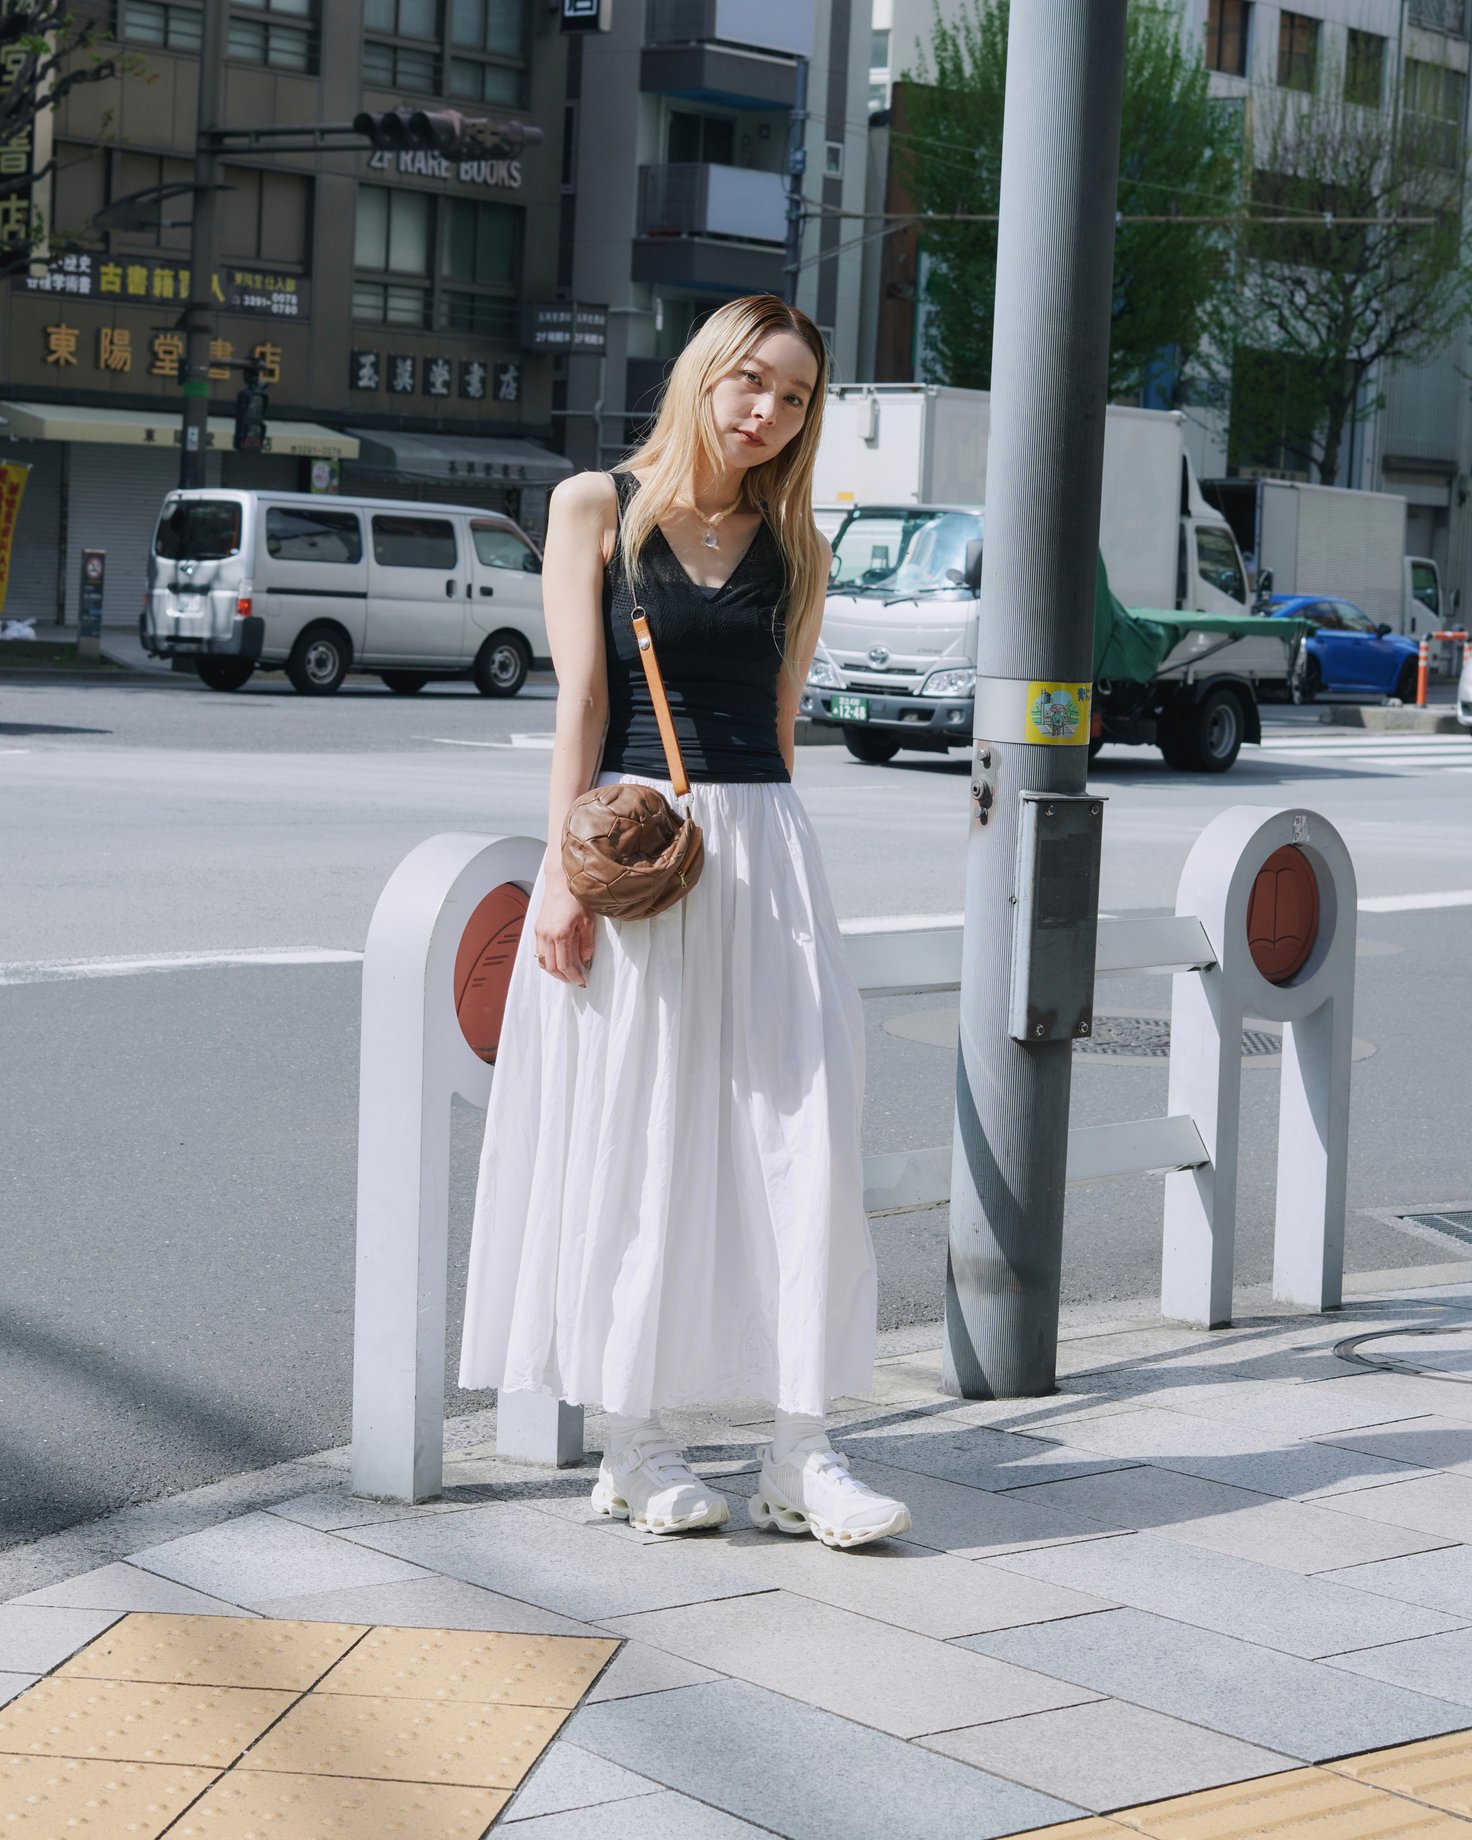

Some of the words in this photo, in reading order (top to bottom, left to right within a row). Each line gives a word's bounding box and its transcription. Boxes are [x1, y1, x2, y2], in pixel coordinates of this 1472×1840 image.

[398, 150, 452, 178] RARE
[459, 159, 522, 189] BOOKS
[357, 352, 520, 401] 玉英堂書店
